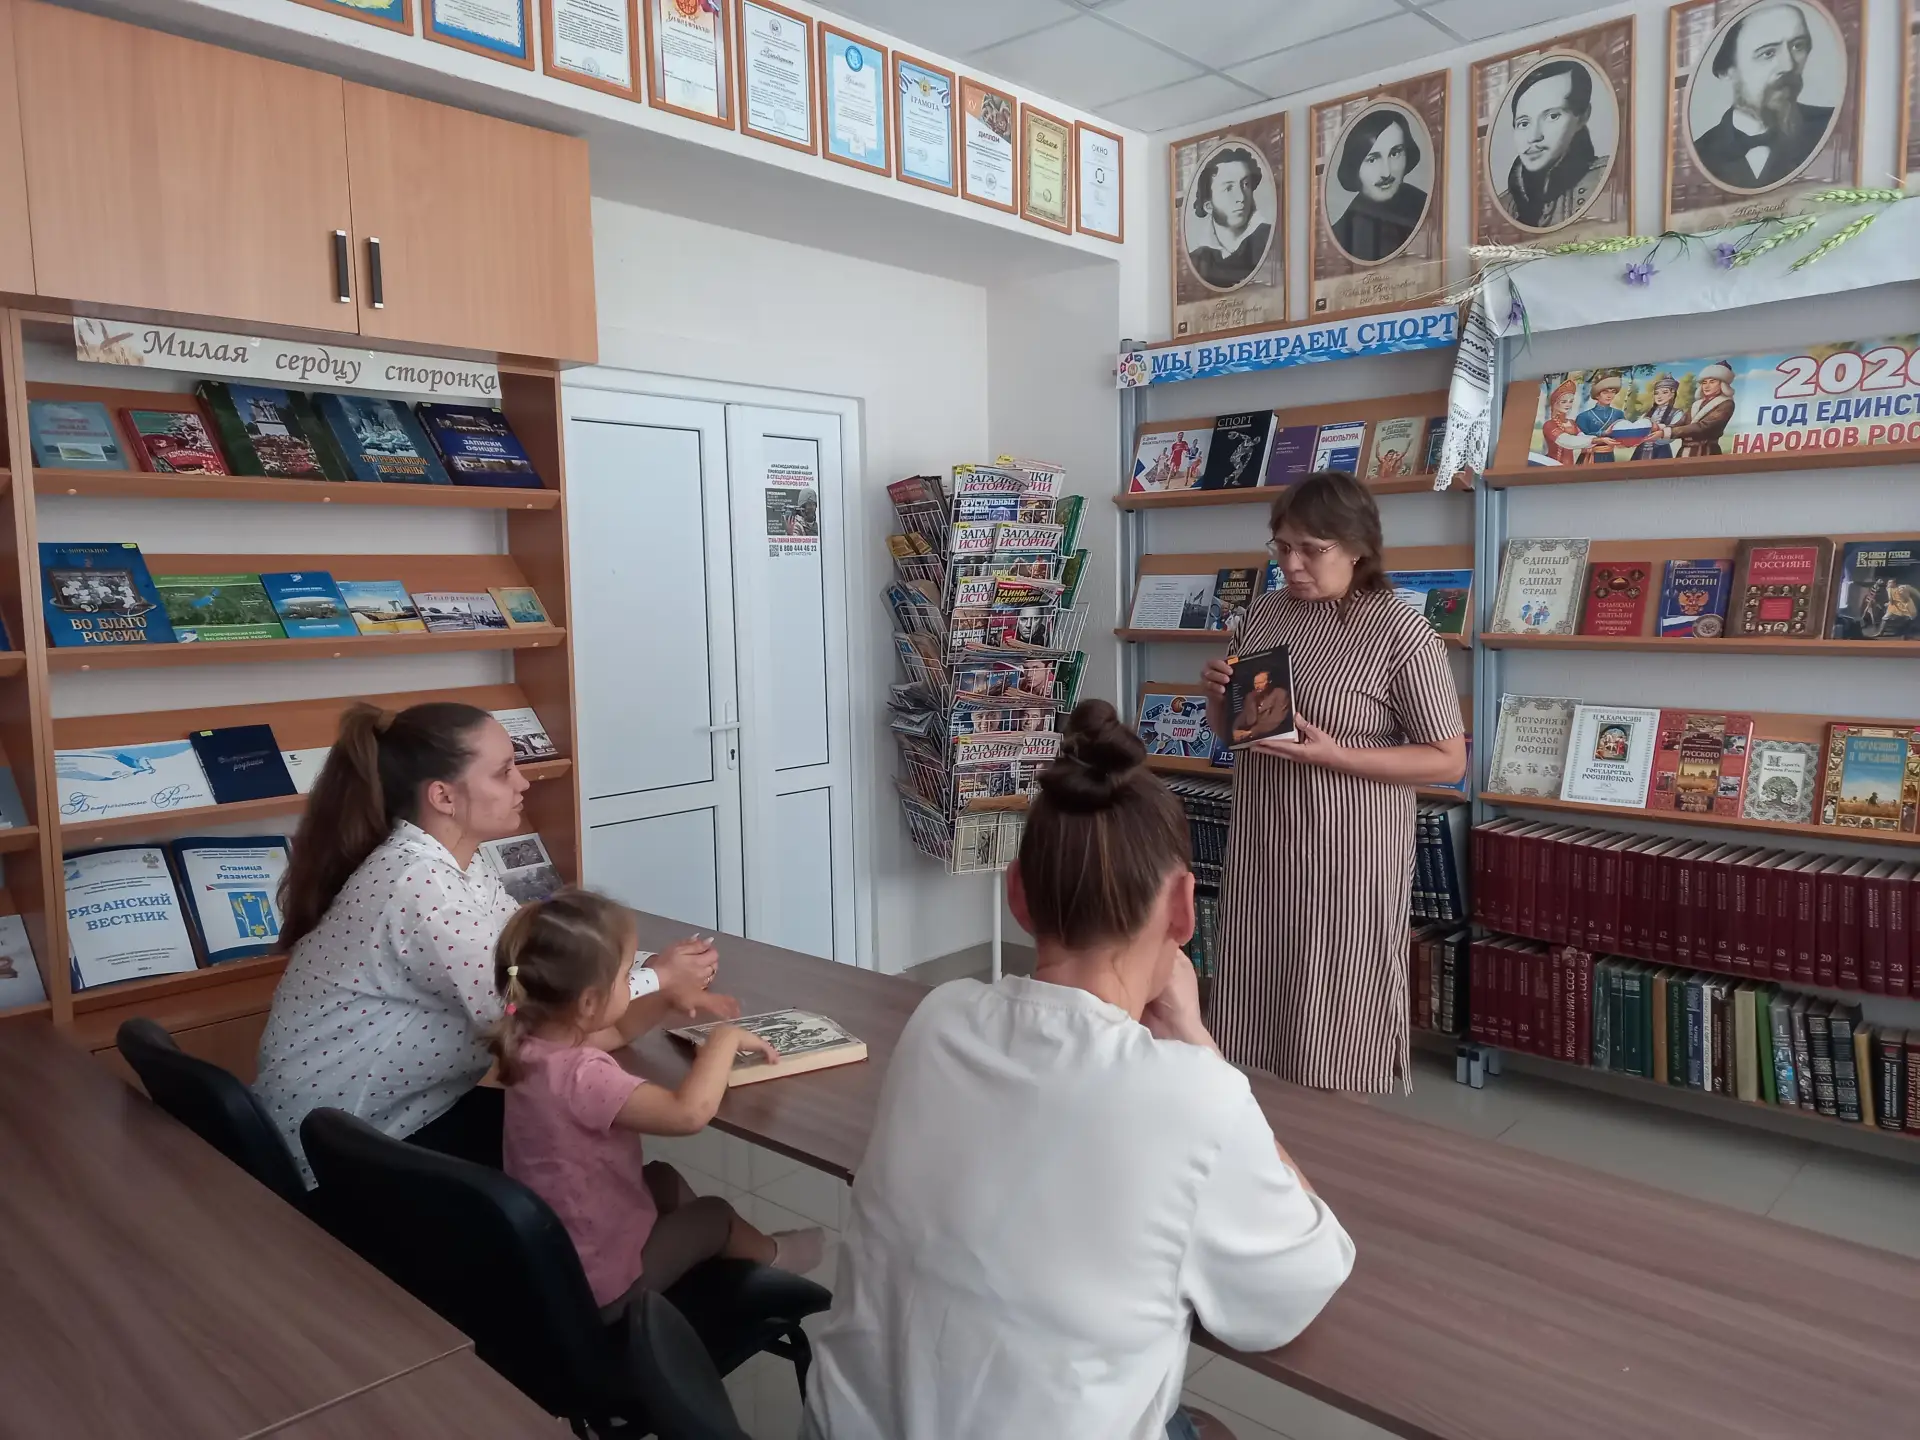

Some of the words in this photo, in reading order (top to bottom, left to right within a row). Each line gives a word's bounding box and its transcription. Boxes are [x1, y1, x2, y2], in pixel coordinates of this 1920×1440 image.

[910, 95, 940, 112] ГРАМОТА
[978, 130, 1000, 143] ДИПЛОМ
[1091, 144, 1108, 155] ОКНО
[1151, 351, 1192, 375] МЫ
[1198, 326, 1349, 367] ВЫБИРАЕМ
[1357, 311, 1458, 344] СПОРТ
[143, 330, 249, 364] Милая
[275, 347, 362, 384] сердцу
[385, 364, 498, 394] сторонка
[1757, 402, 1808, 427] ГОД
[1217, 415, 1253, 428] СПОРТ
[462, 438, 502, 448] ЗАПИСКИ
[1320, 433, 1359, 444] ФИЗКУЛЬТУРА
[1732, 426, 1860, 454] НАРОДОВ
[465, 445, 507, 454] ОФИЦЕРА
[360, 455, 377, 465] ТРИ
[378, 464, 398, 474] ДВЕ
[964, 482, 1023, 492] ИСТОРИИ
[961, 528, 995, 539] ЗАГАД
[1003, 528, 1058, 539] ЗАГАДКИ
[958, 538, 995, 549] ИСТОР
[1000, 538, 1057, 548] ИСТОРИИ
[1754, 560, 1811, 569] РОССИЯНЕ
[1528, 567, 1557, 576] НАРОД
[1675, 578, 1718, 586] РОССИИ
[963, 583, 995, 594] ЗАГАД
[1522, 587, 1557, 595] СТРАНА
[960, 592, 994, 603] ИСТОР
[71, 618, 92, 630] ВО
[99, 616, 148, 629] БЛАГО
[82, 630, 147, 643] РОССИИ
[1514, 716, 1559, 726] ИСТОРИЯ
[1173, 727, 1195, 738] СПОРТ
[1515, 725, 1564, 735] КУЛЬТУРА
[1517, 736, 1558, 745] НАРОДОВ
[963, 743, 1018, 753] ЗАГАДКИ
[1022, 745, 1055, 755] ОРИИ
[1514, 745, 1558, 756] РОССИИ
[961, 751, 1017, 761] ИСТОРИИ
[1219, 751, 1234, 762] ДЗ
[1682, 750, 1720, 759] РУССКОГО
[1593, 762, 1625, 770] ИСТОРИЯ
[1585, 768, 1632, 776] ГОСУДАРСТВА
[1582, 773, 1635, 783] РОССИЙСКОГО
[67, 893, 172, 920] РЯЗАНСКИЙ
[86, 910, 168, 931] ВЕСТНИК
[1718, 941, 1727, 949] 15
[1777, 949, 1786, 957] 18
[1821, 954, 1832, 963] 20
[1870, 960, 1881, 969] 22
[1891, 963, 1903, 972] 23
[1566, 968, 1577, 991] СССР
[1565, 991, 1577, 1019] КНИГА
